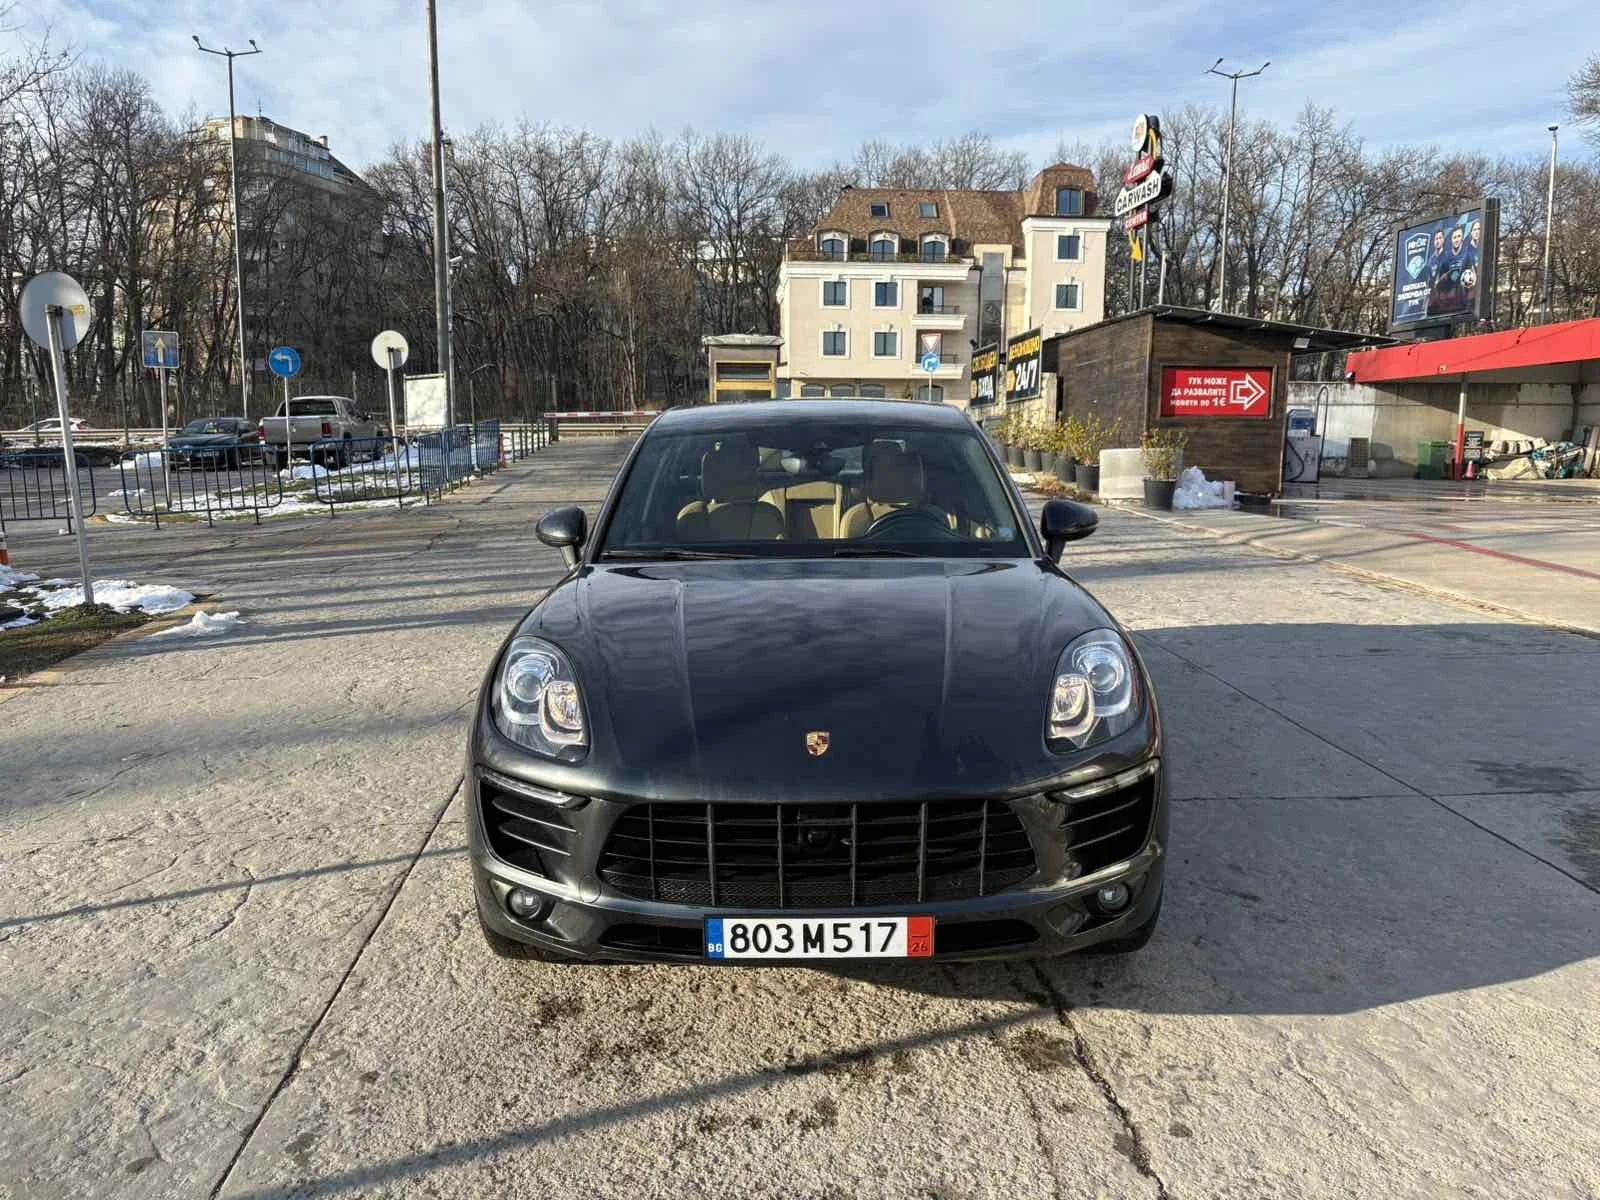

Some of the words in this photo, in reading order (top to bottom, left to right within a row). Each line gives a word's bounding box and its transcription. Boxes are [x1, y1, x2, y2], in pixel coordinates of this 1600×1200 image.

[1117, 178, 1159, 212] CARWASH
[1188, 377, 1202, 385] ТУК
[1204, 377, 1228, 385] МОЖЕ
[1171, 388, 1181, 396] ДА
[708, 943, 723, 953] BG
